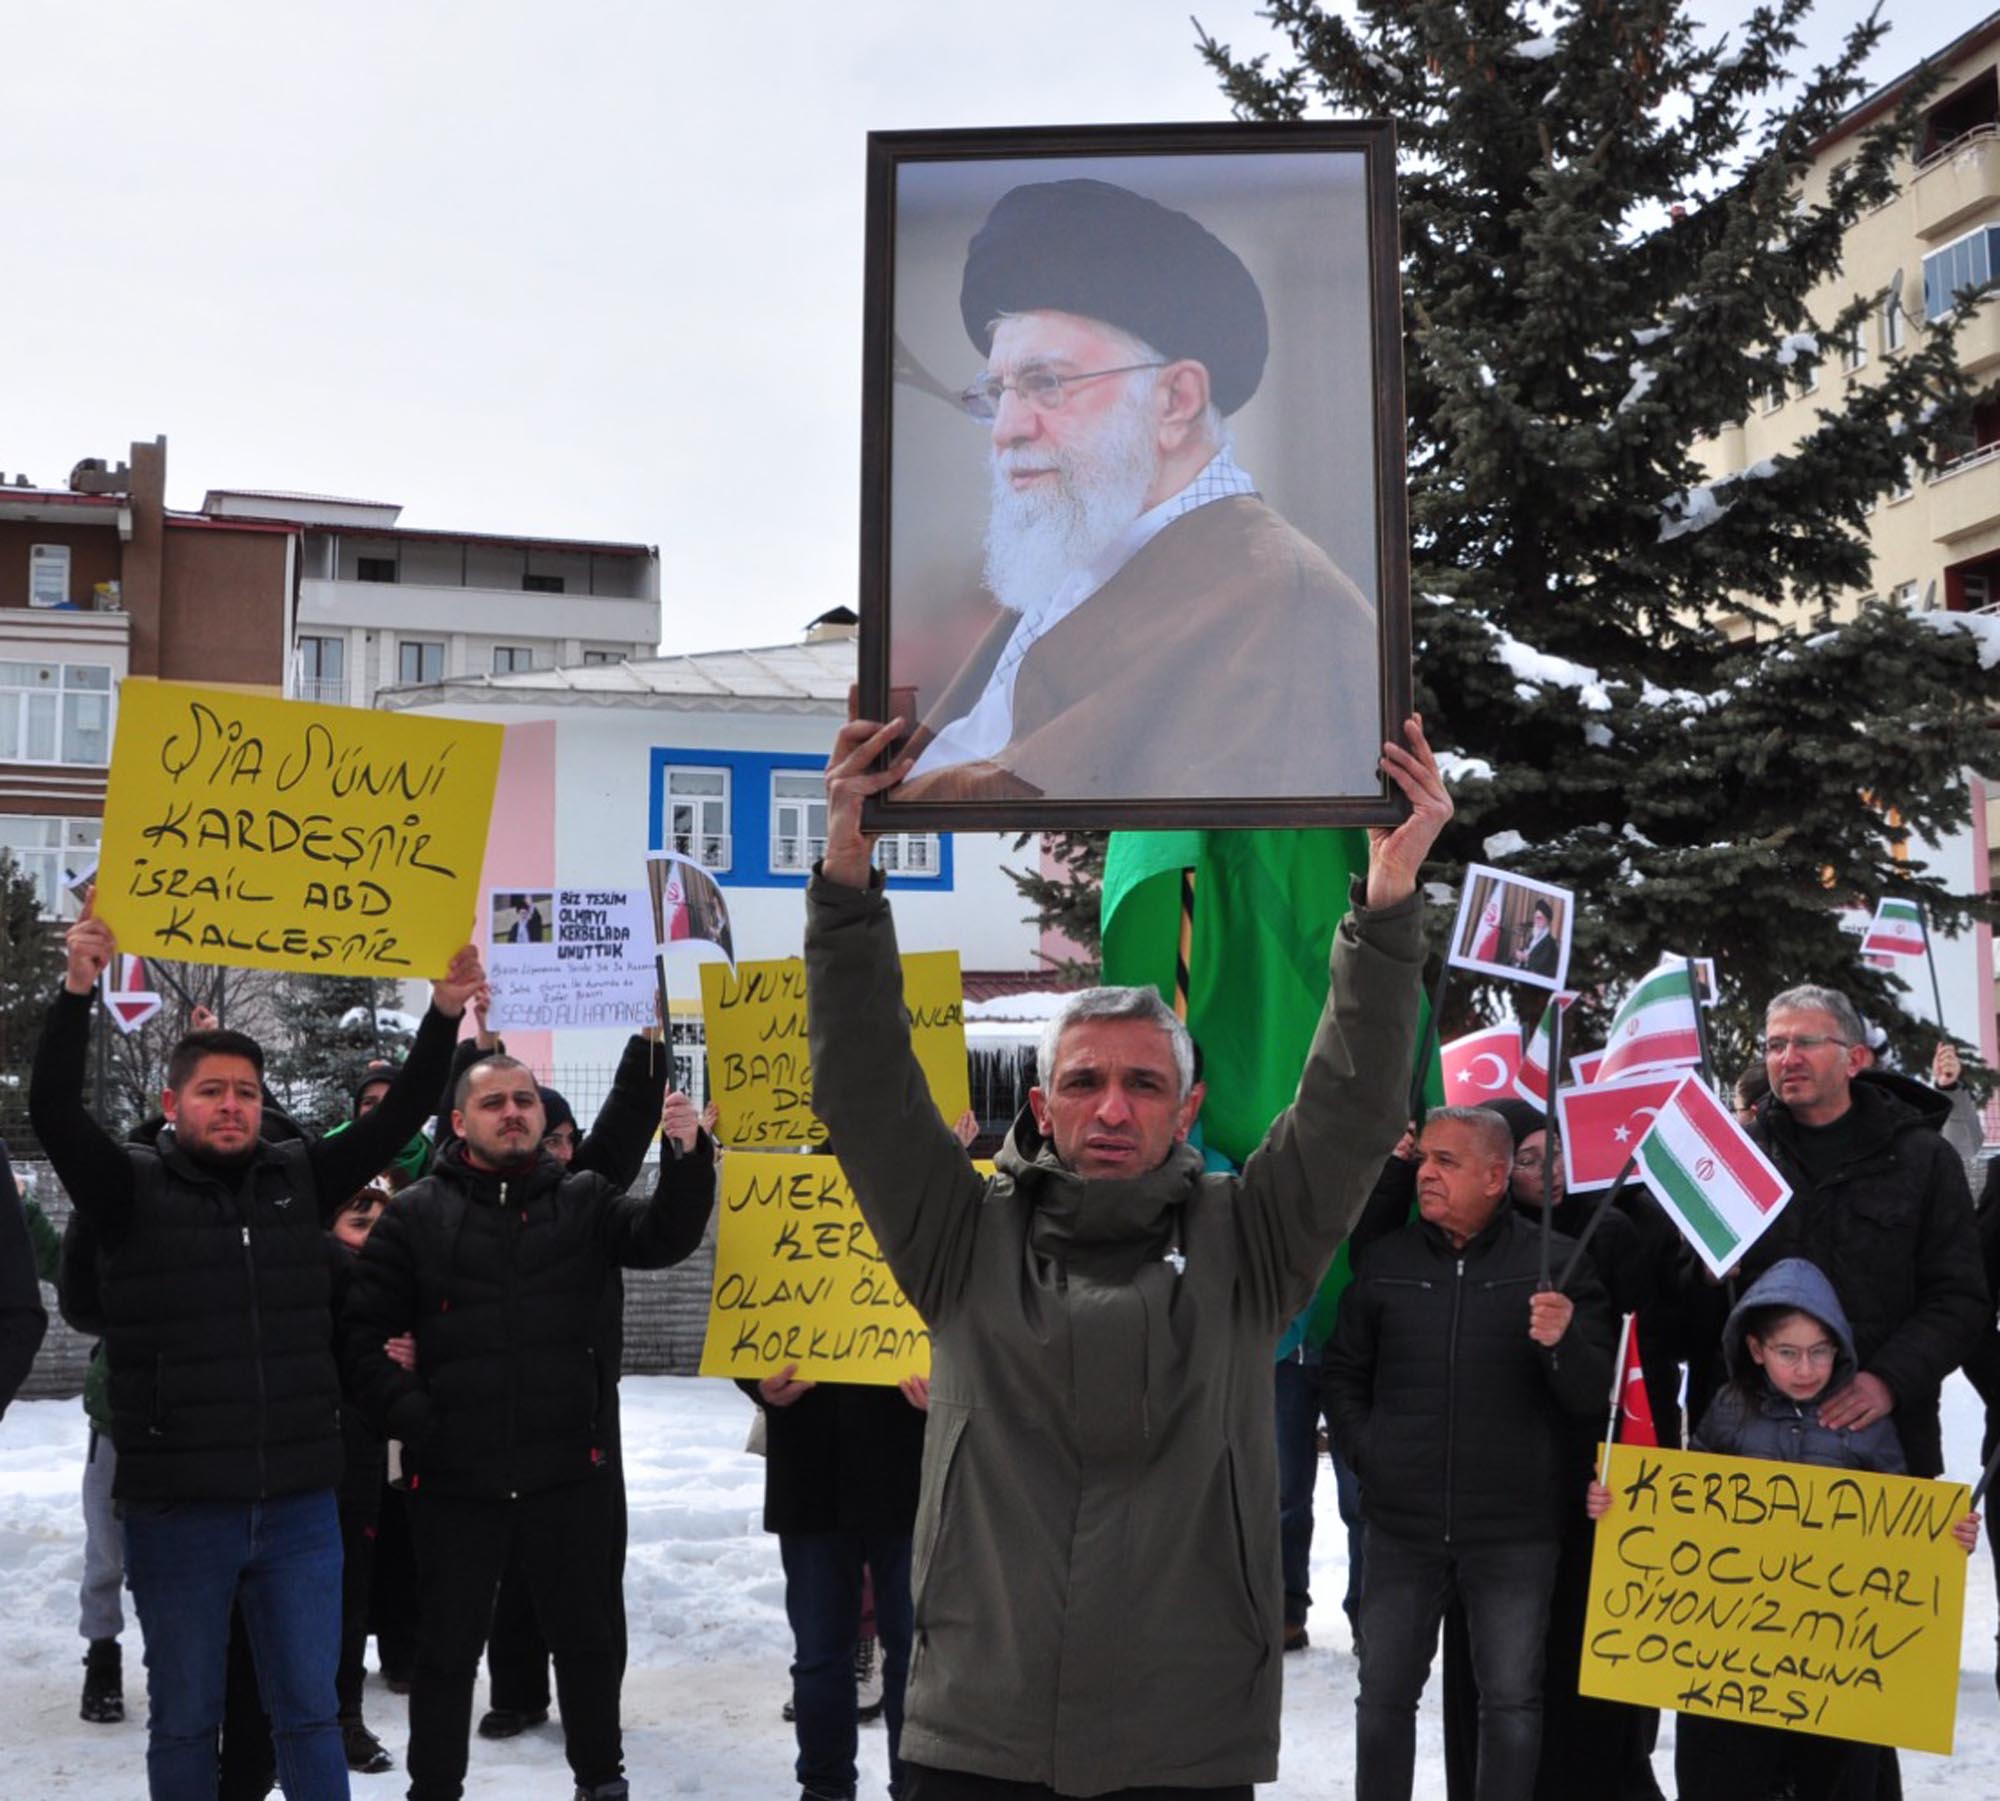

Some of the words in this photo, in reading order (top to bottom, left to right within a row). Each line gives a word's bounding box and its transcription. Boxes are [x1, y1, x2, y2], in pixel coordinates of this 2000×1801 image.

[161, 702, 264, 785] ŞİA
[276, 723, 457, 800] SÜNNİ
[142, 801, 457, 879] KARDEŞTİR
[129, 858, 275, 902] İSRAİL
[303, 881, 392, 916] ABD
[559, 908, 607, 926] OLMAYI
[559, 925, 630, 942] KERBELADA
[557, 943, 623, 960] UNUTTUK
[728, 1173, 855, 1212] MEK
[716, 1273, 835, 1311] OLANI
[1624, 1458, 1964, 1542] KERBALANIN
[1618, 1525, 1939, 1616] ÇOCUKLARI
[1604, 1576, 1924, 1660] SİYONİZMİN
[1677, 1678, 1829, 1725] KARŞI
